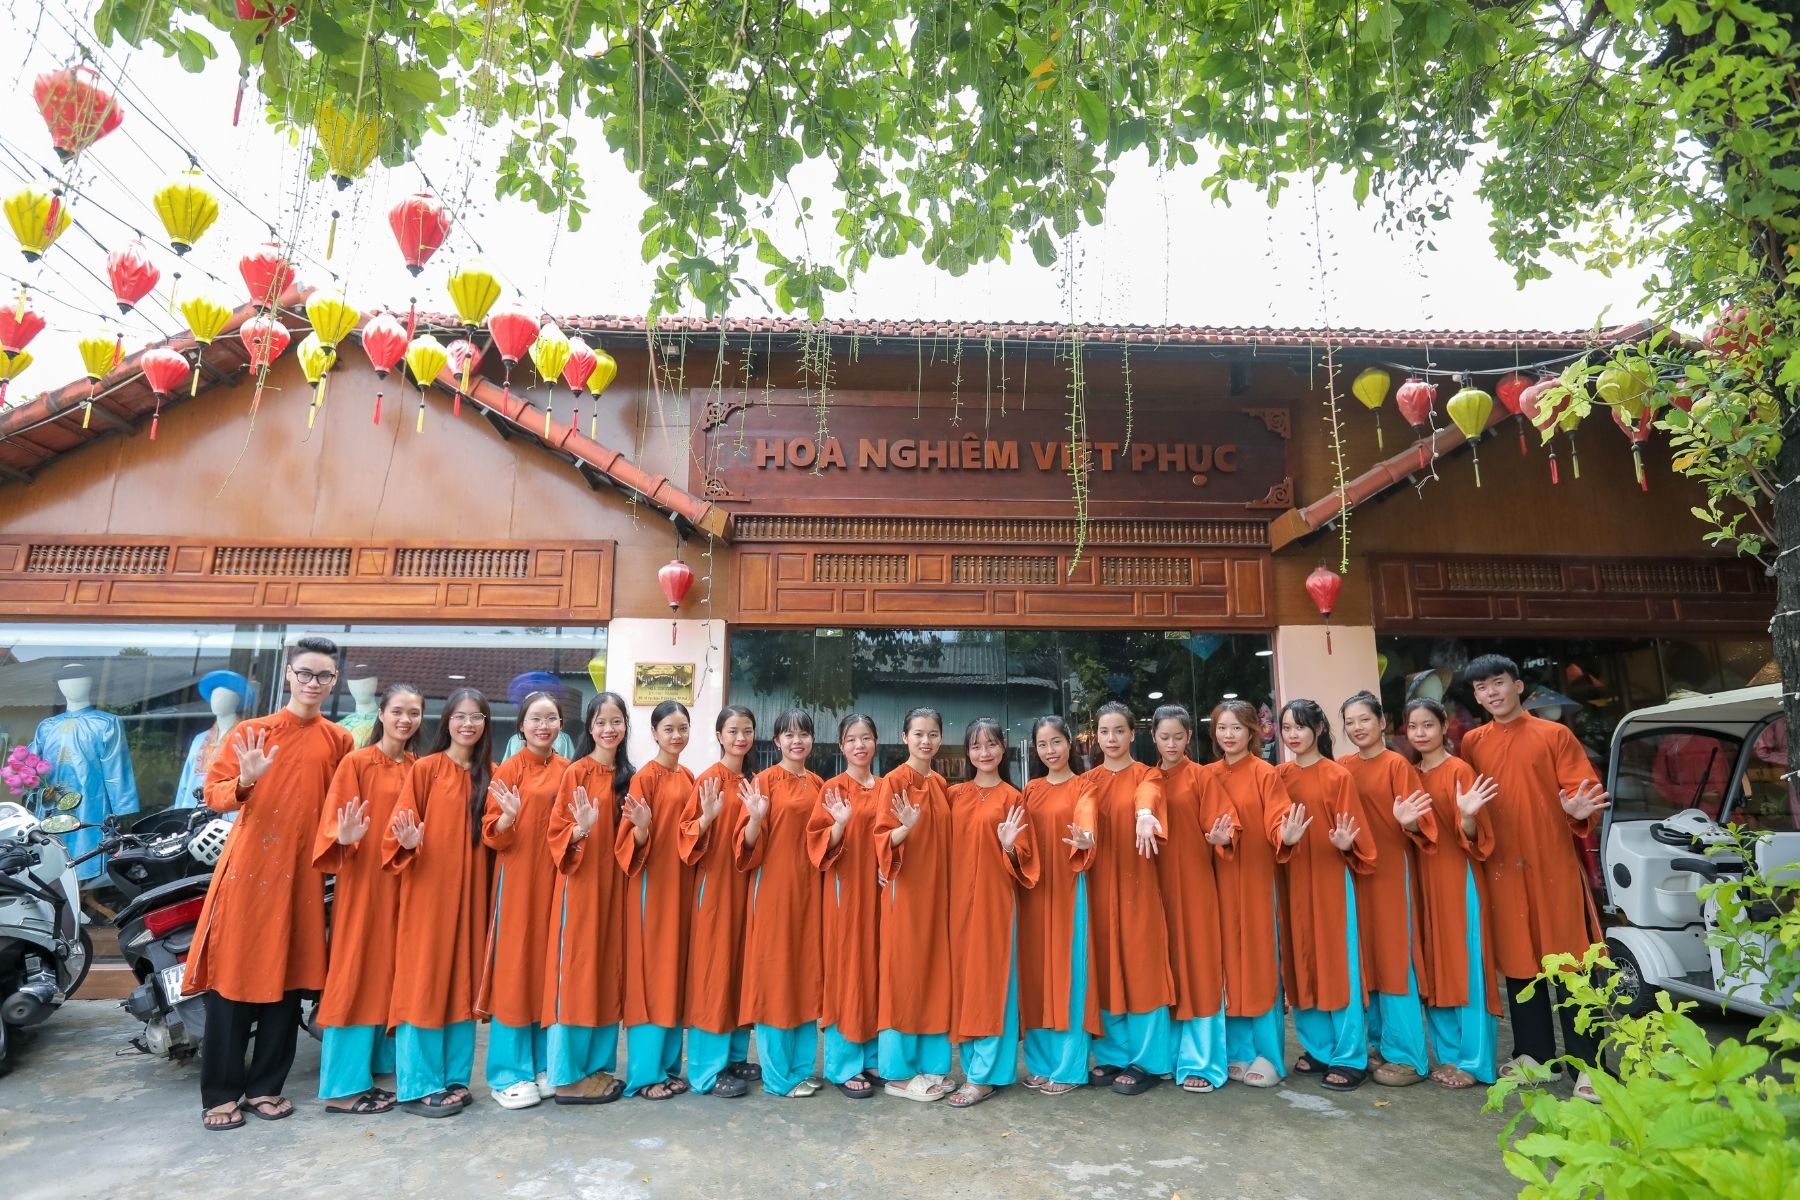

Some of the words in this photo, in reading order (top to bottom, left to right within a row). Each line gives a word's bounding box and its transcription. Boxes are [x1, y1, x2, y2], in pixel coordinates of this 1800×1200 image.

[757, 437, 847, 468] HOA
[859, 432, 1019, 469] NGHIÊM
[1131, 442, 1238, 486] PHỤC
